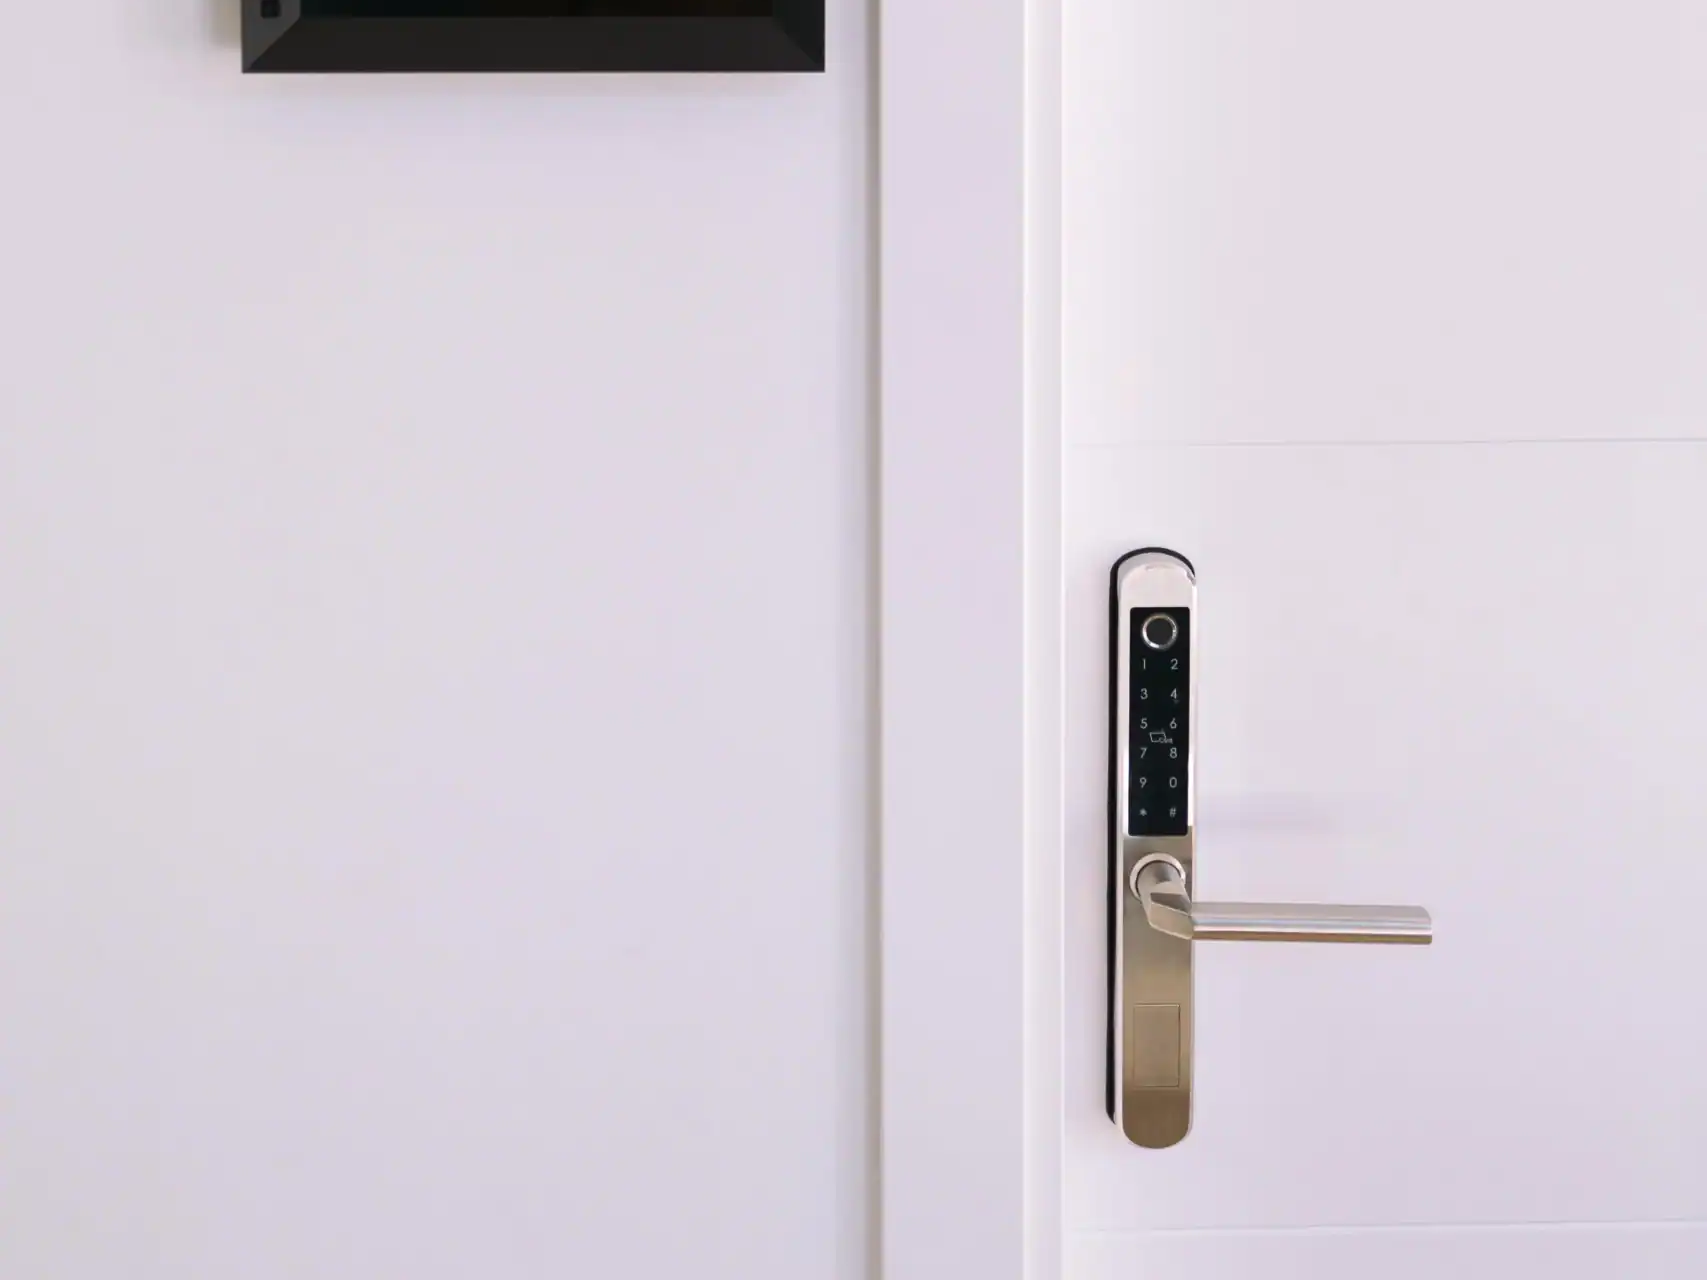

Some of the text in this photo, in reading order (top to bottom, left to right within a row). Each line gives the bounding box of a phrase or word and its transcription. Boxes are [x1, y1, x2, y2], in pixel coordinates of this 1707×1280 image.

[1170, 658, 1178, 670] 2
[1140, 688, 1177, 700] 3 4
[1140, 718, 1177, 729] 5 6
[1140, 747, 1177, 759] 7 8
[1140, 777, 1177, 788] 9 0
